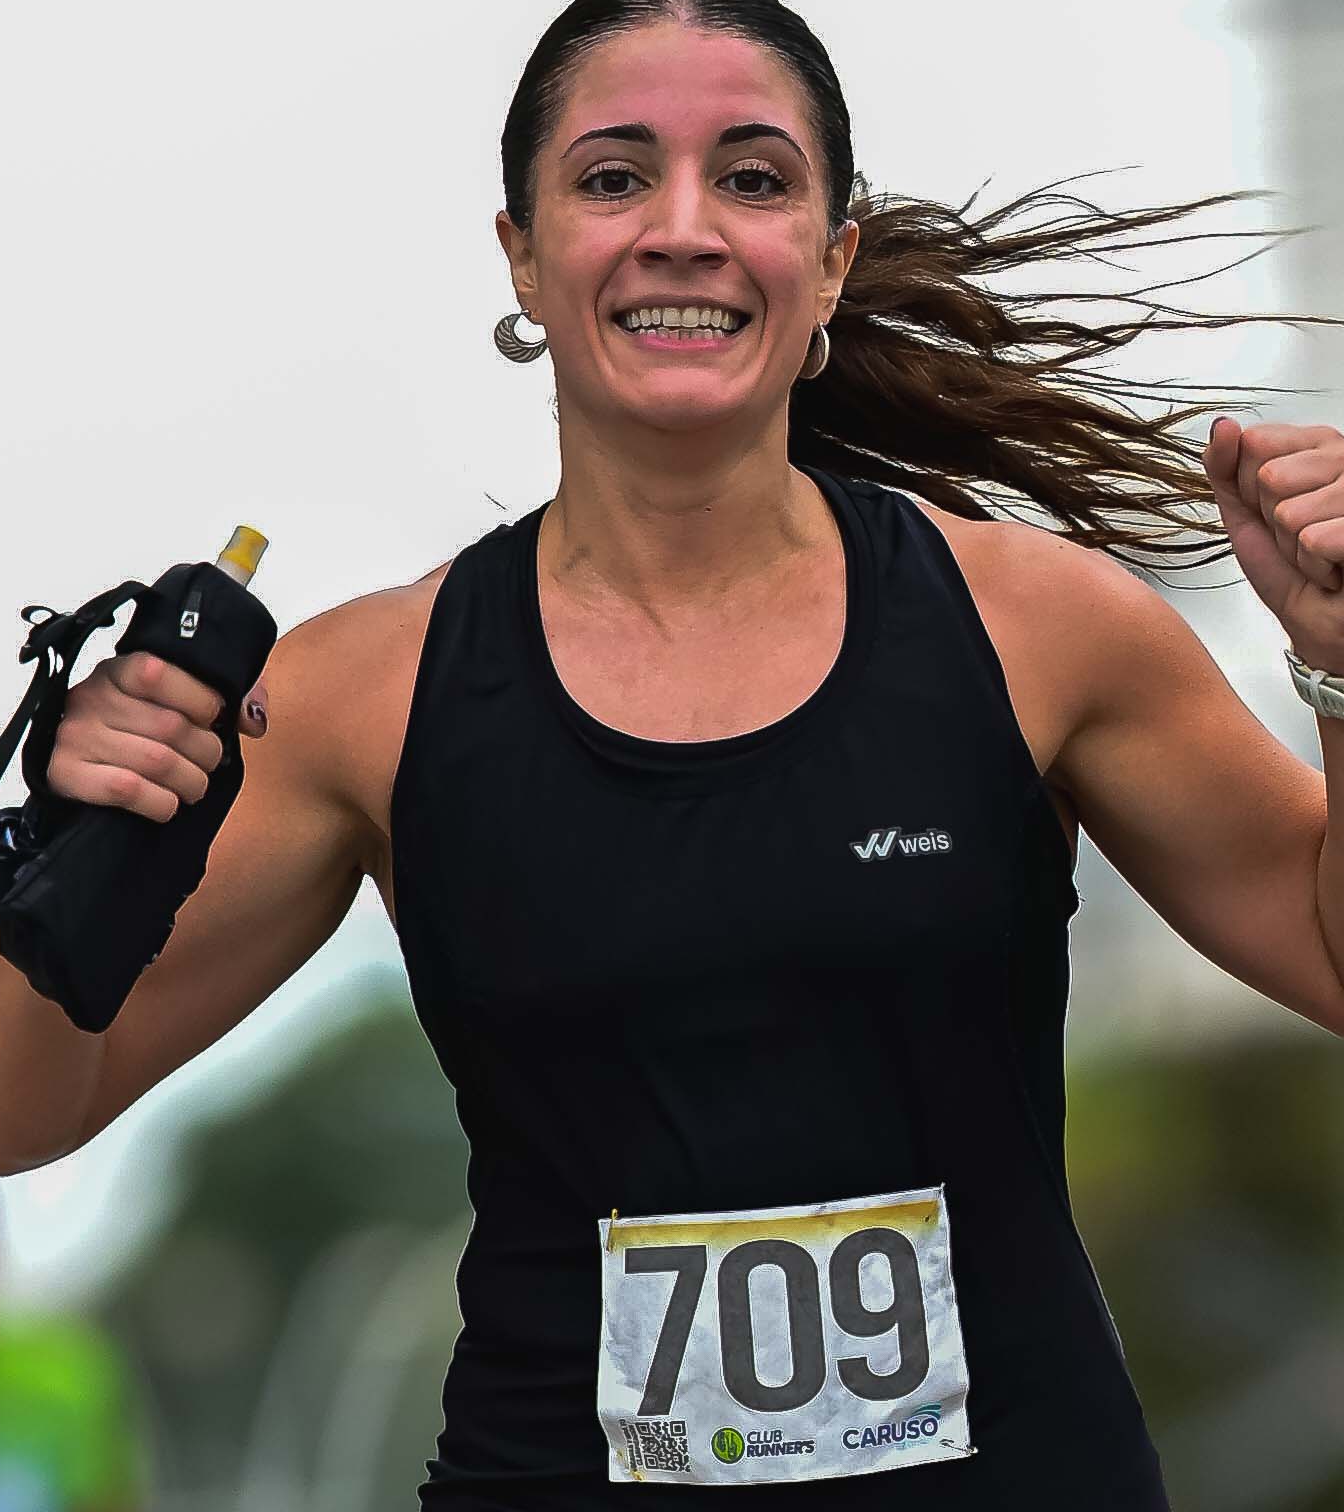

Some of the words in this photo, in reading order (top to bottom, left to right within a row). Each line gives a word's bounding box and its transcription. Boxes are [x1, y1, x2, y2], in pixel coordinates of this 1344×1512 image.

[624, 1227, 928, 1416] 709
[746, 1430, 783, 1444] CLUB
[842, 1417, 938, 1450] CARUSO
